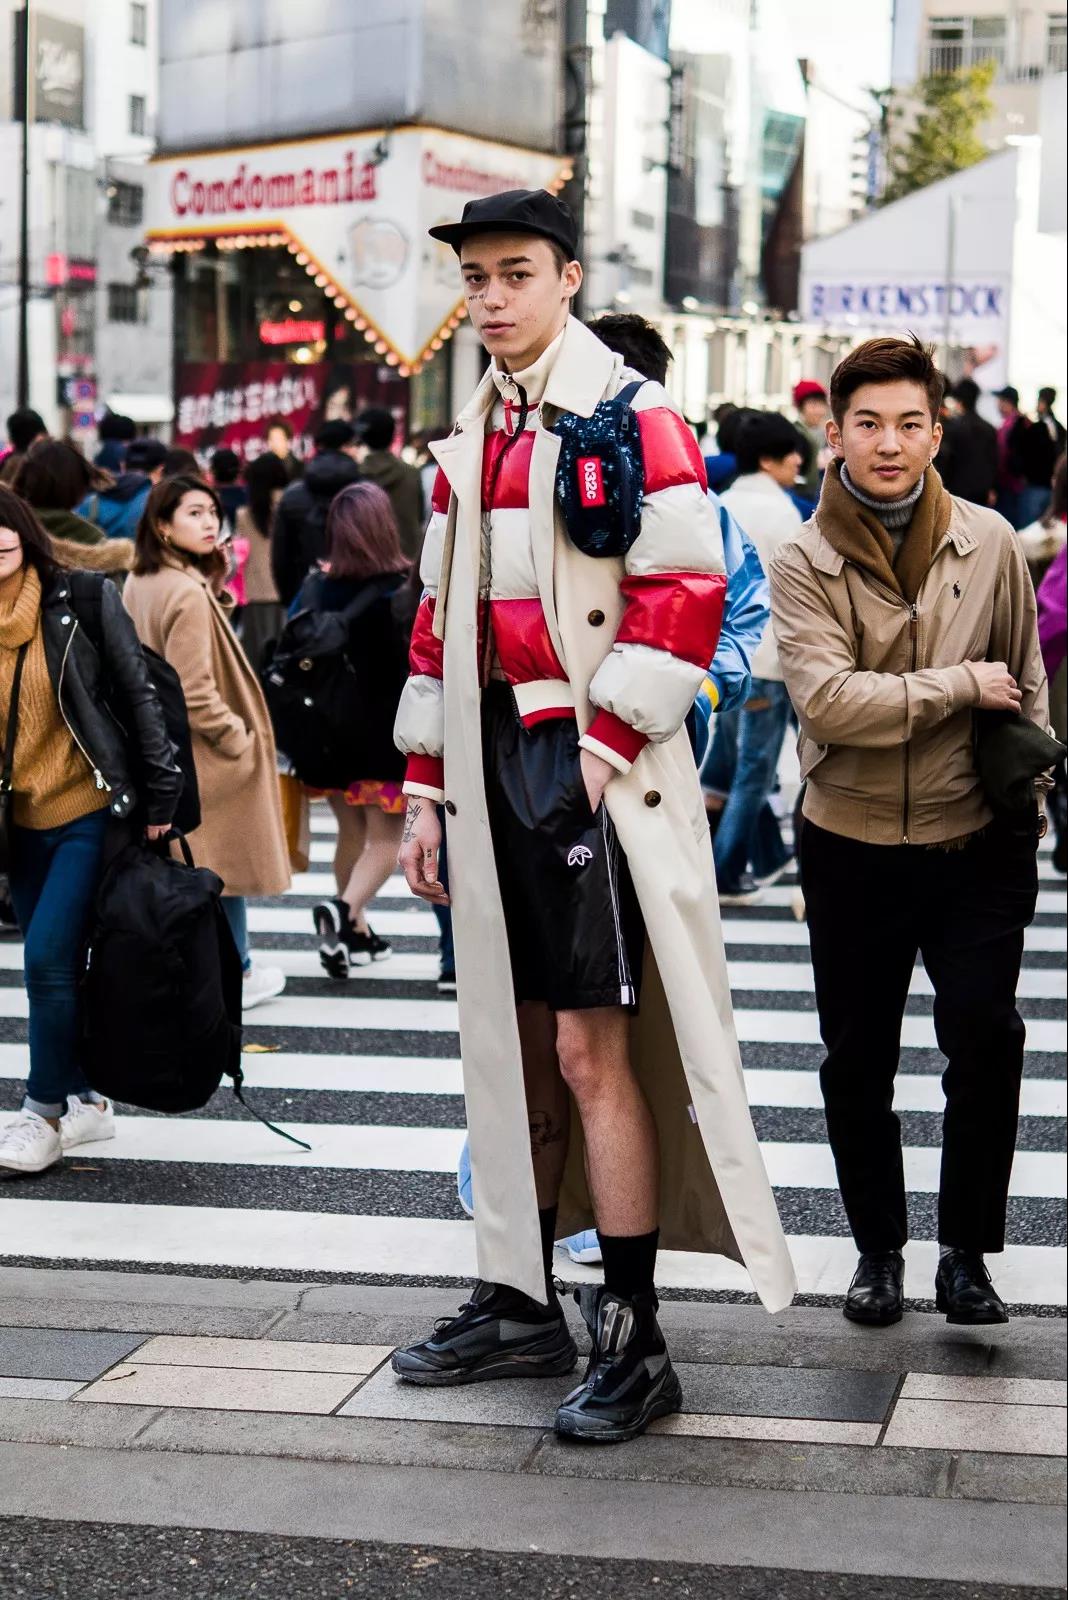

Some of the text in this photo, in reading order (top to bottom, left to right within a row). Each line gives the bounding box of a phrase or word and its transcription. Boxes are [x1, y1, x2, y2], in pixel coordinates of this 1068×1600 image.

[171, 152, 376, 217] Condomania
[811, 284, 1002, 317] BIRKENSTOCK
[584, 461, 598, 500] 032c
